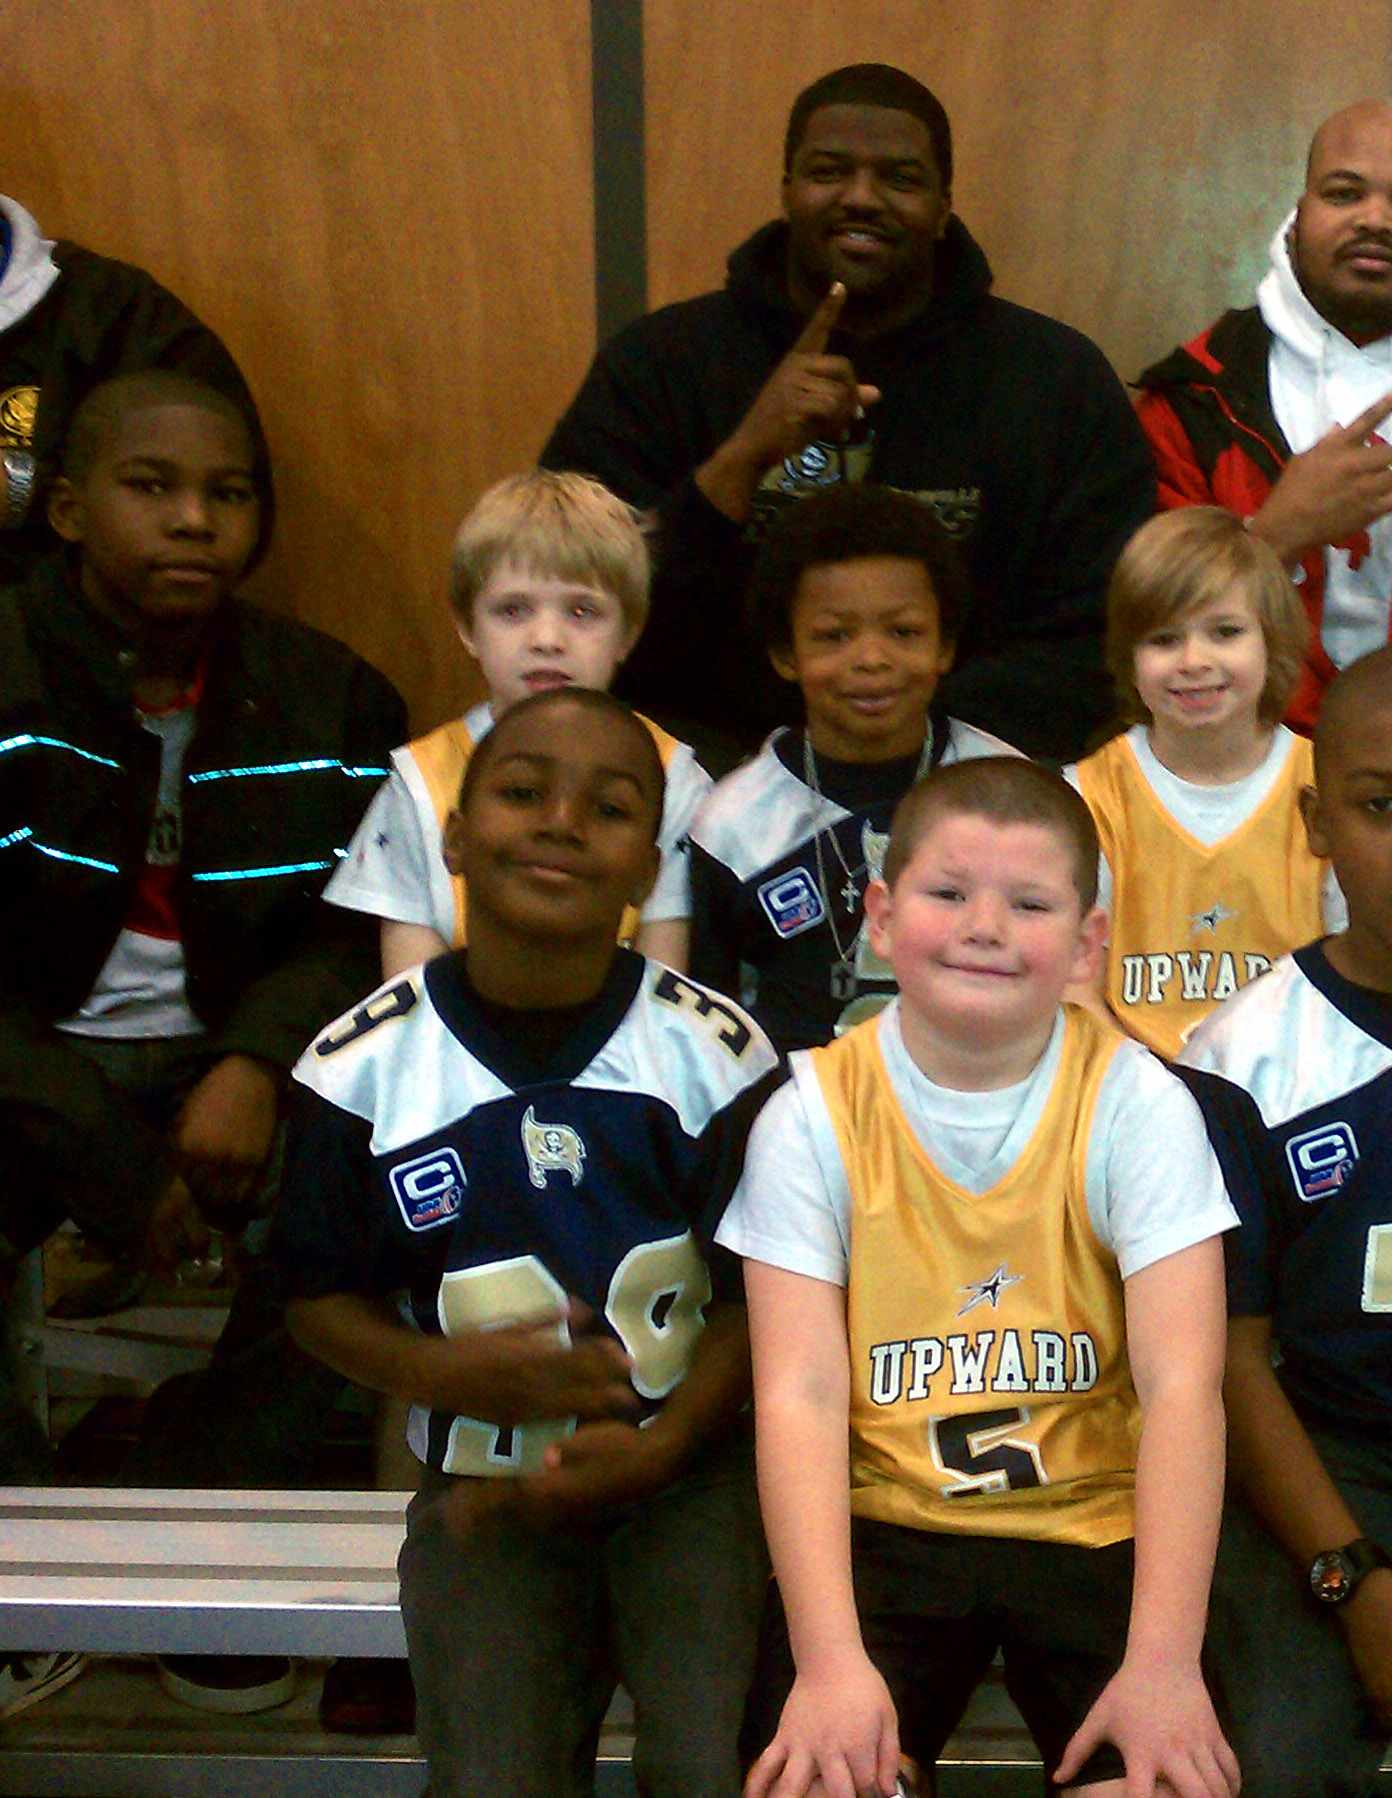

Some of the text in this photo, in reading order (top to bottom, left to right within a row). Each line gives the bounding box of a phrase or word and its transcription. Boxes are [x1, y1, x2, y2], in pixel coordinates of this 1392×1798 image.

[402, 1160, 453, 1201] C
[1296, 1135, 1348, 1171] C
[869, 1328, 1100, 1406] UPWARD
[927, 1405, 1049, 1499] 5
